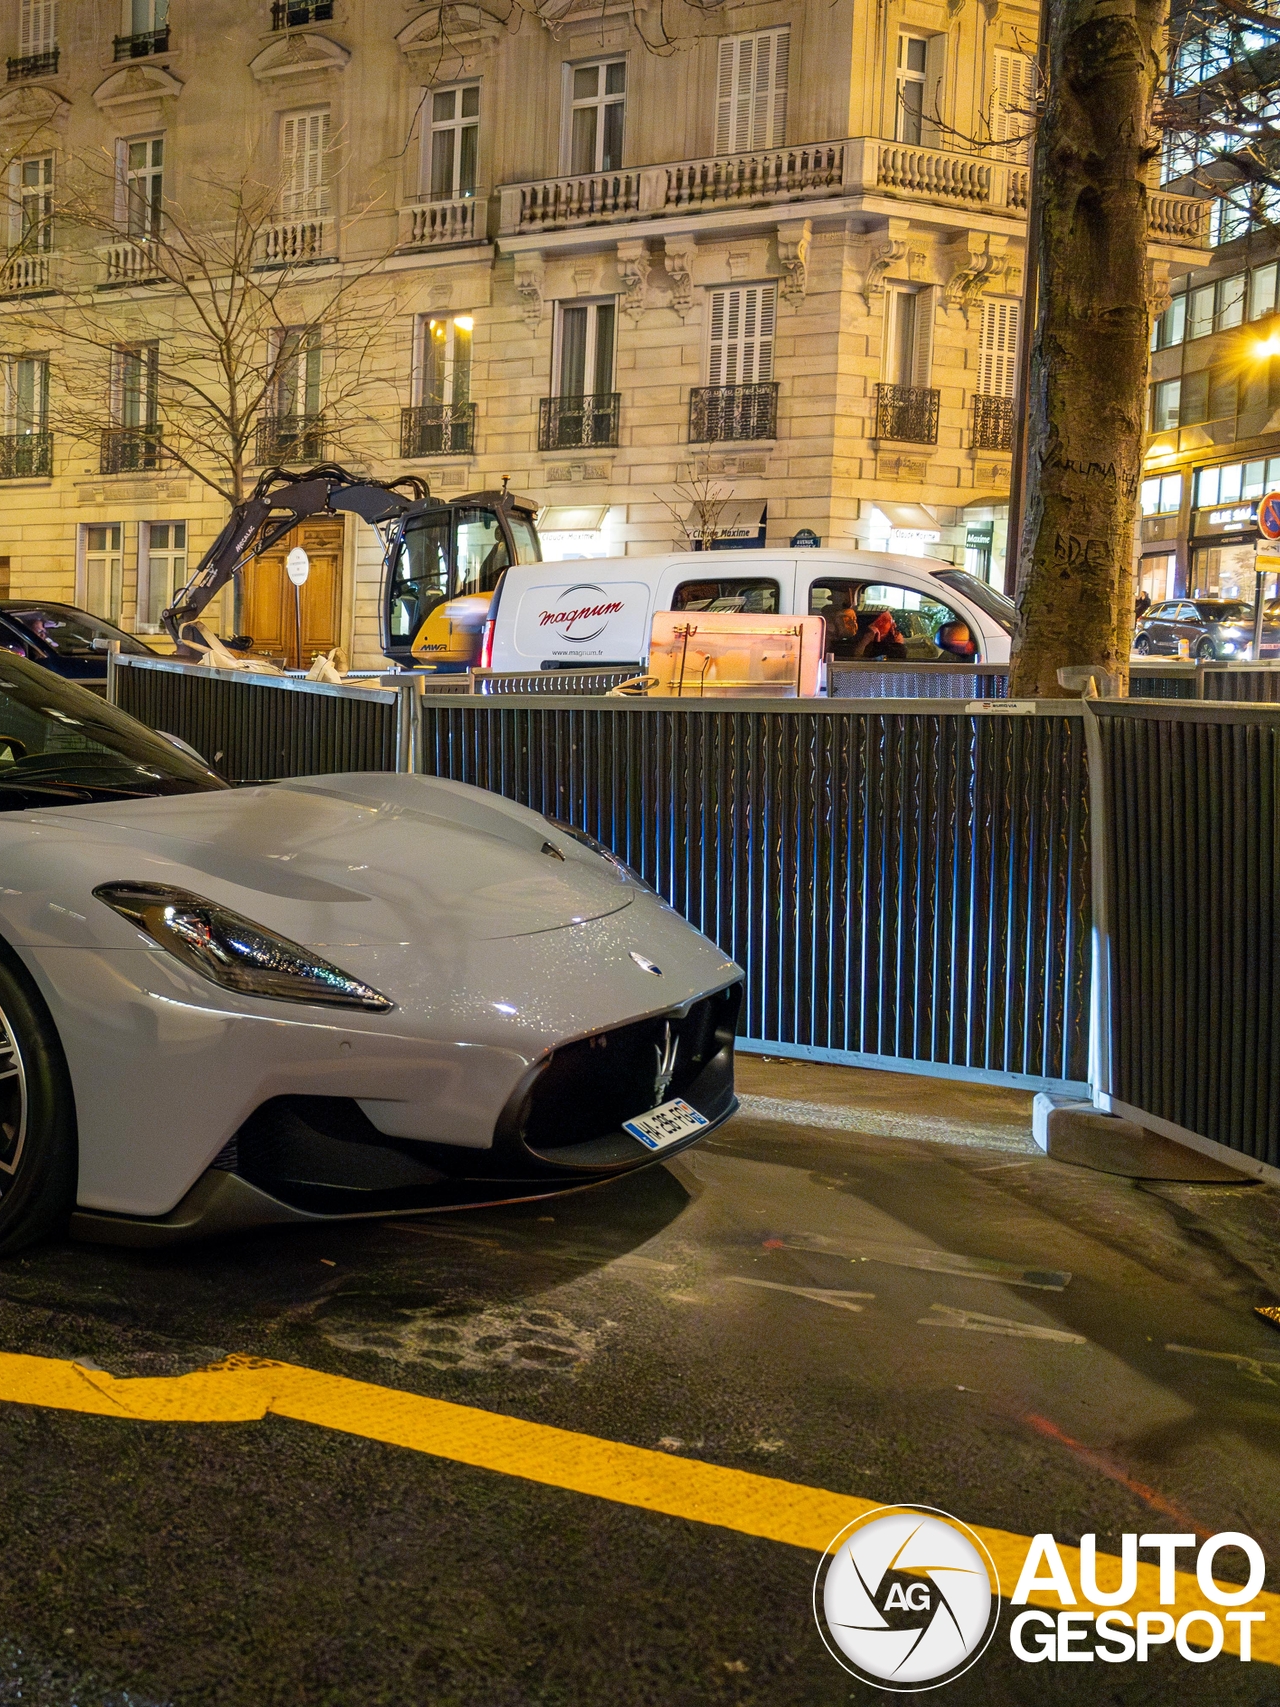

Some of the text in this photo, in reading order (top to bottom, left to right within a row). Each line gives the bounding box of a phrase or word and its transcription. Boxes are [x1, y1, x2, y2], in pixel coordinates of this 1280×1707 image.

[720, 529, 751, 538] Maxime
[538, 601, 625, 632] magnum
[551, 649, 604, 657] www.magnum.fr
